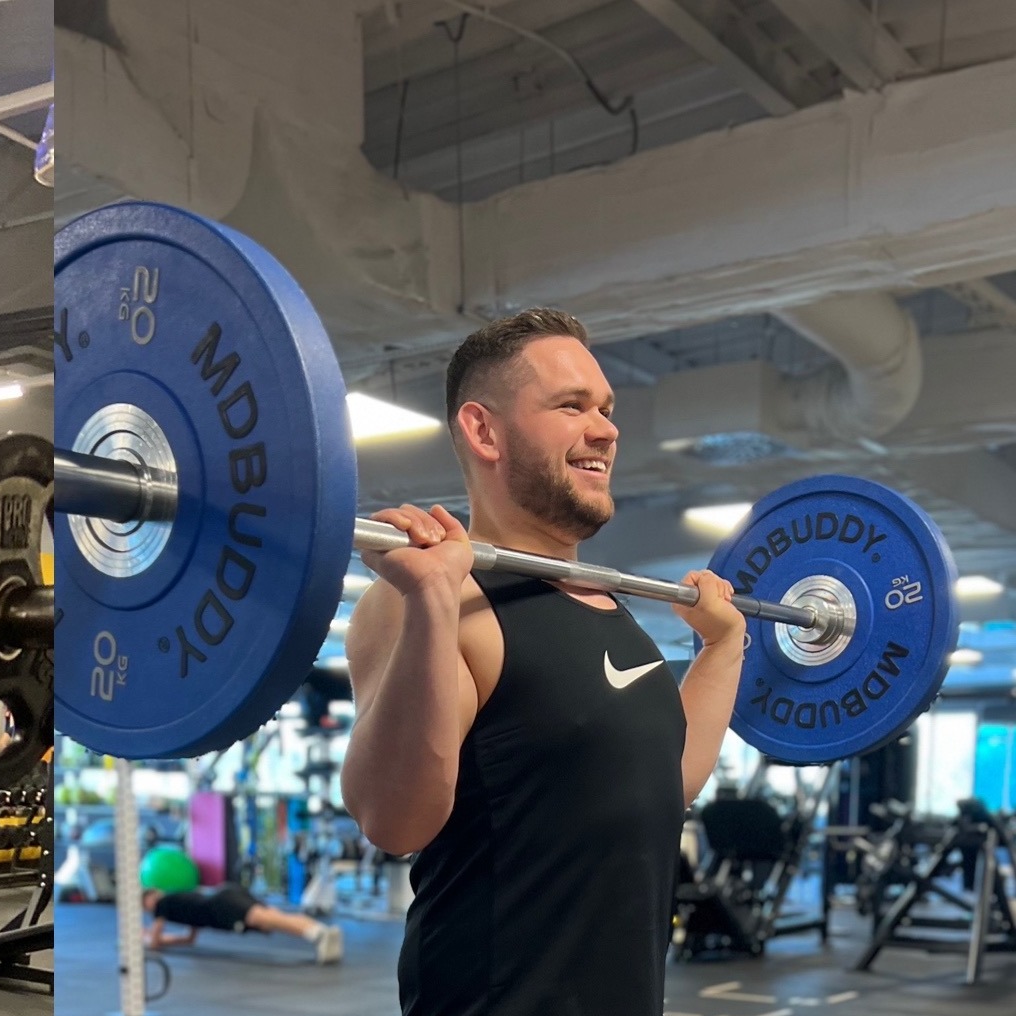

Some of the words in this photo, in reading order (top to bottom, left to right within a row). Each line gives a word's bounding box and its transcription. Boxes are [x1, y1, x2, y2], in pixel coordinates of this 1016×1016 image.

[120, 287, 131, 320] KG
[131, 266, 159, 345] 20
[885, 581, 924, 610] 20
[892, 574, 909, 586] KG
[91, 631, 117, 701] 20
[117, 655, 128, 686] KG
